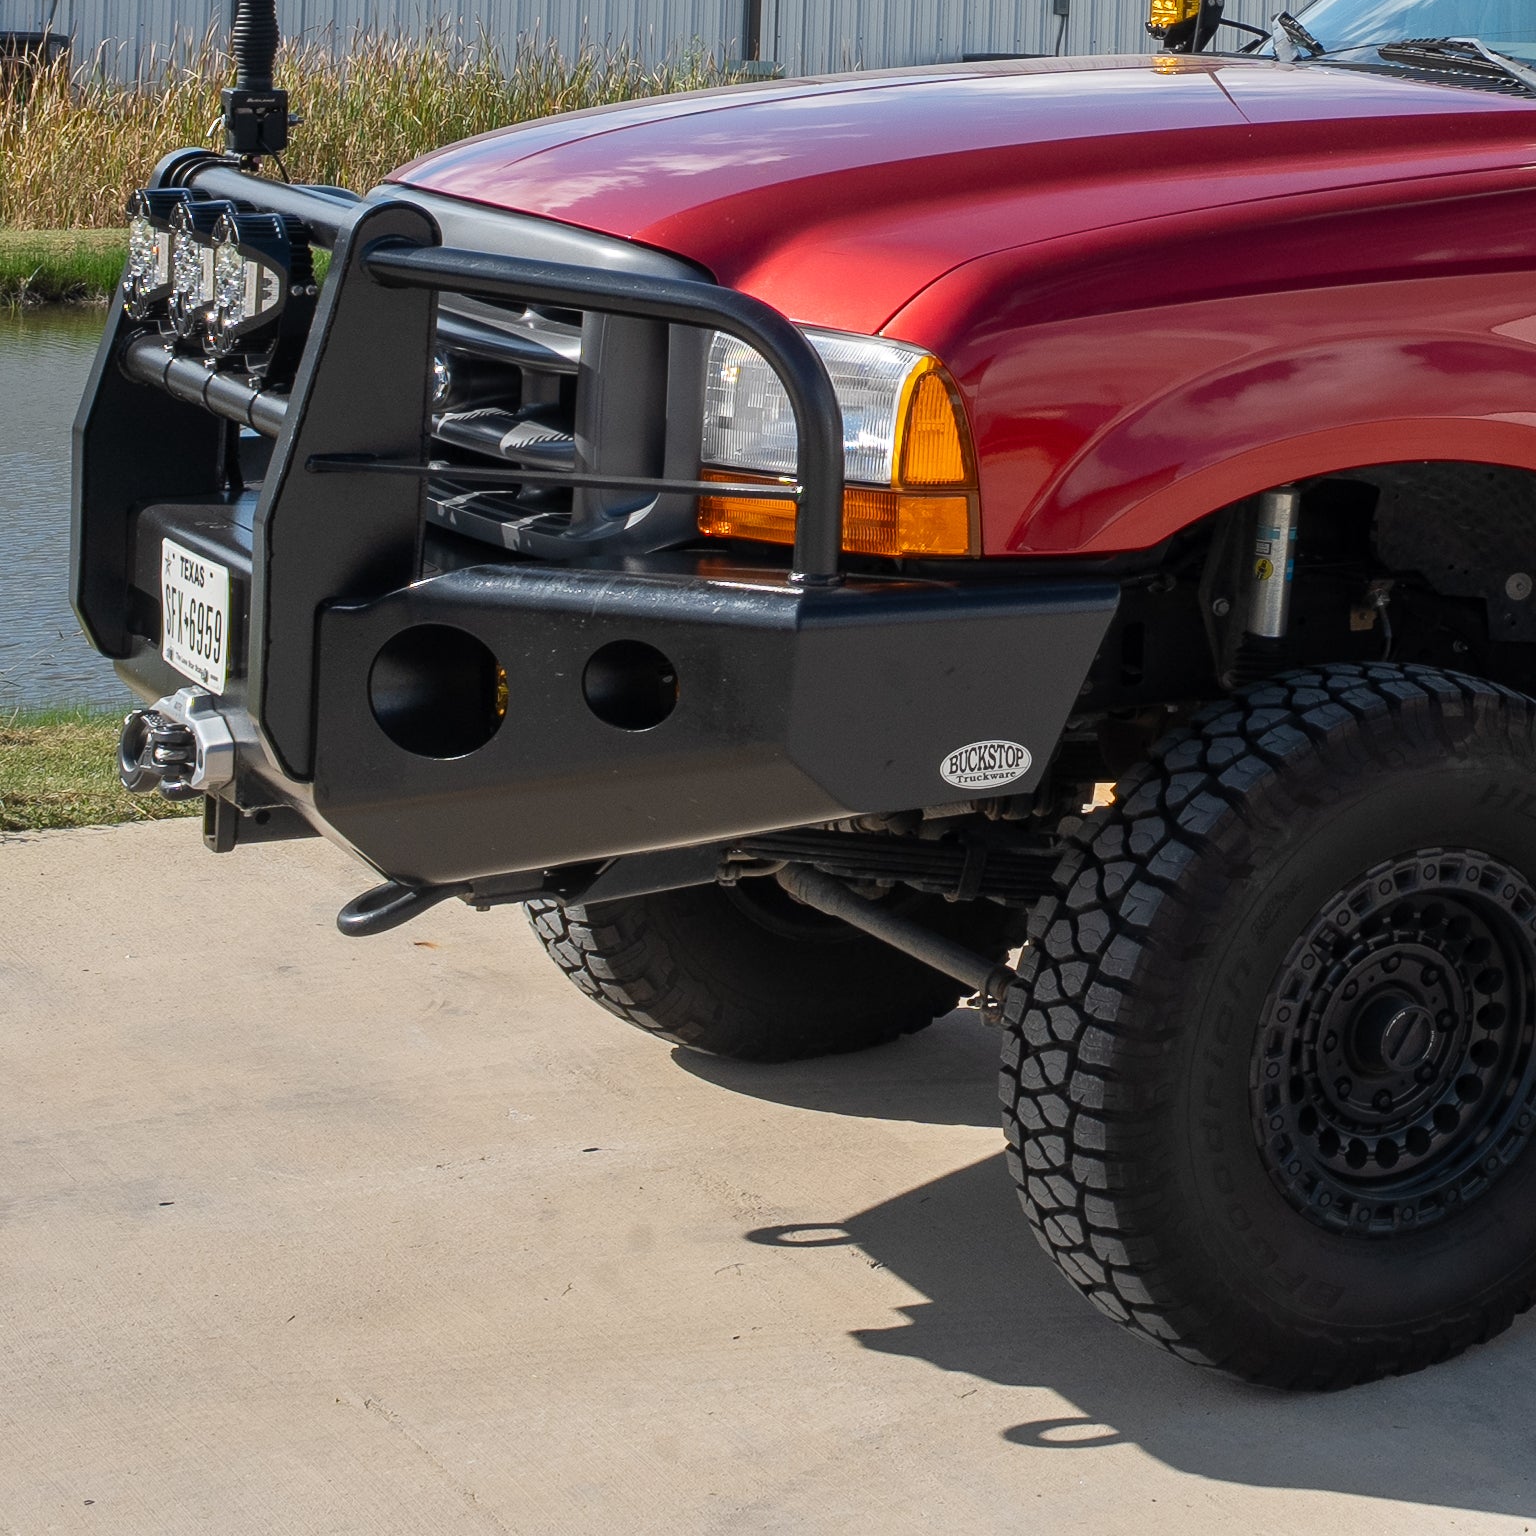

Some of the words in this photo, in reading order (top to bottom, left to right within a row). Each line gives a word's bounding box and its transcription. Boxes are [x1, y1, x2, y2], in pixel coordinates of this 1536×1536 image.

[179, 555, 205, 588] TEXAS
[948, 743, 1024, 775] BUCKSTOP
[956, 771, 1016, 783] Truckware
